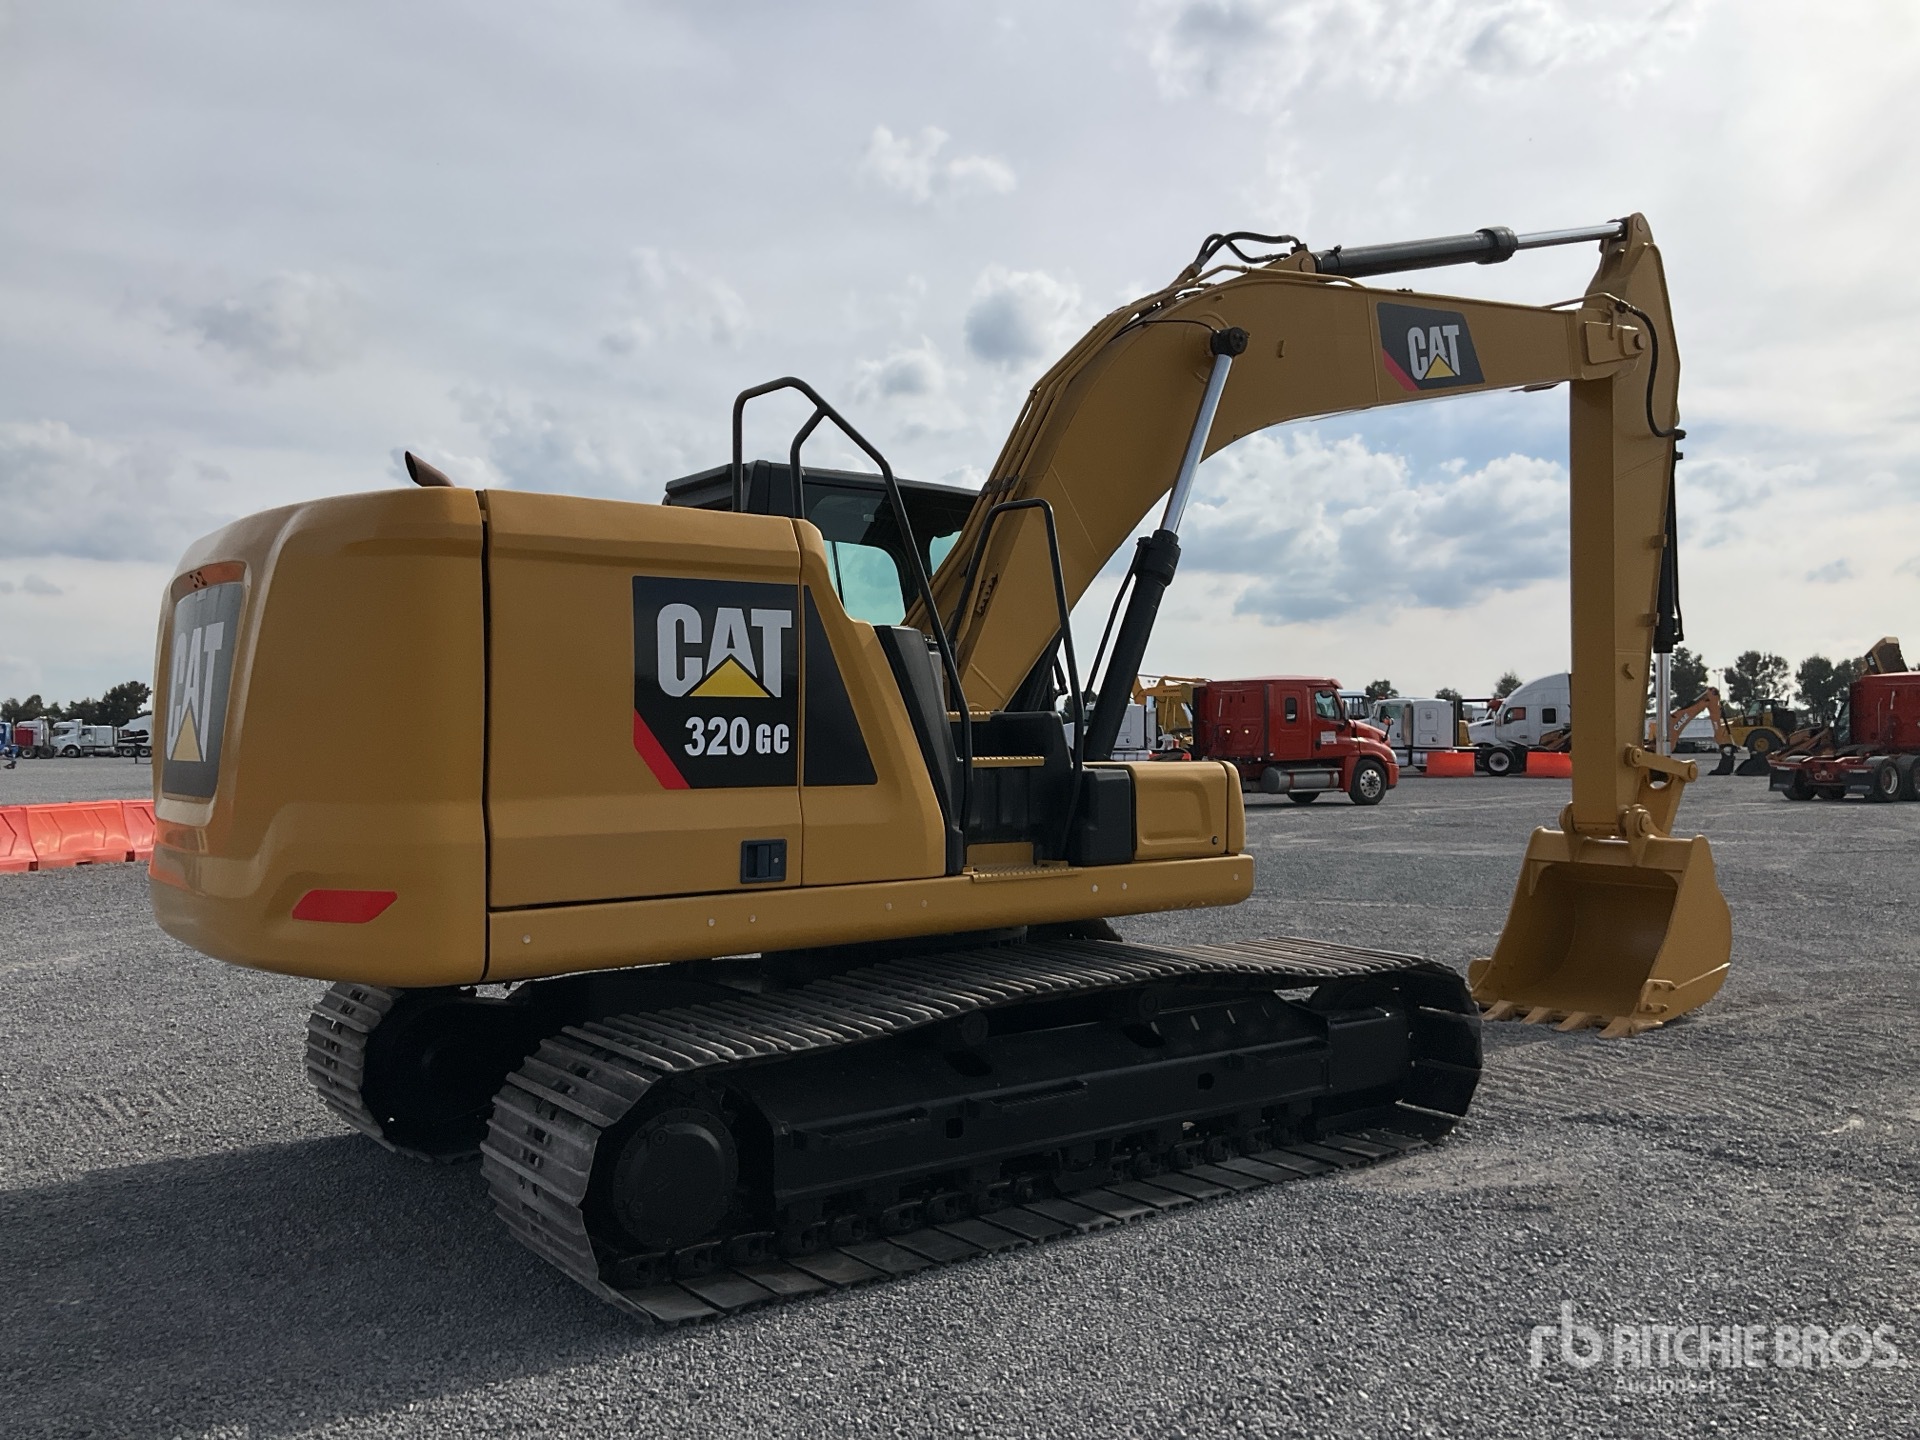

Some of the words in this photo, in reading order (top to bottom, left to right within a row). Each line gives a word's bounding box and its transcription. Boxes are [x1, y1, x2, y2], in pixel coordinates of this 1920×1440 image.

[1407, 324, 1460, 380] CAT
[657, 603, 792, 698] CAT
[166, 621, 225, 762] CAT
[684, 716, 750, 756] 320
[755, 724, 790, 754] GC
